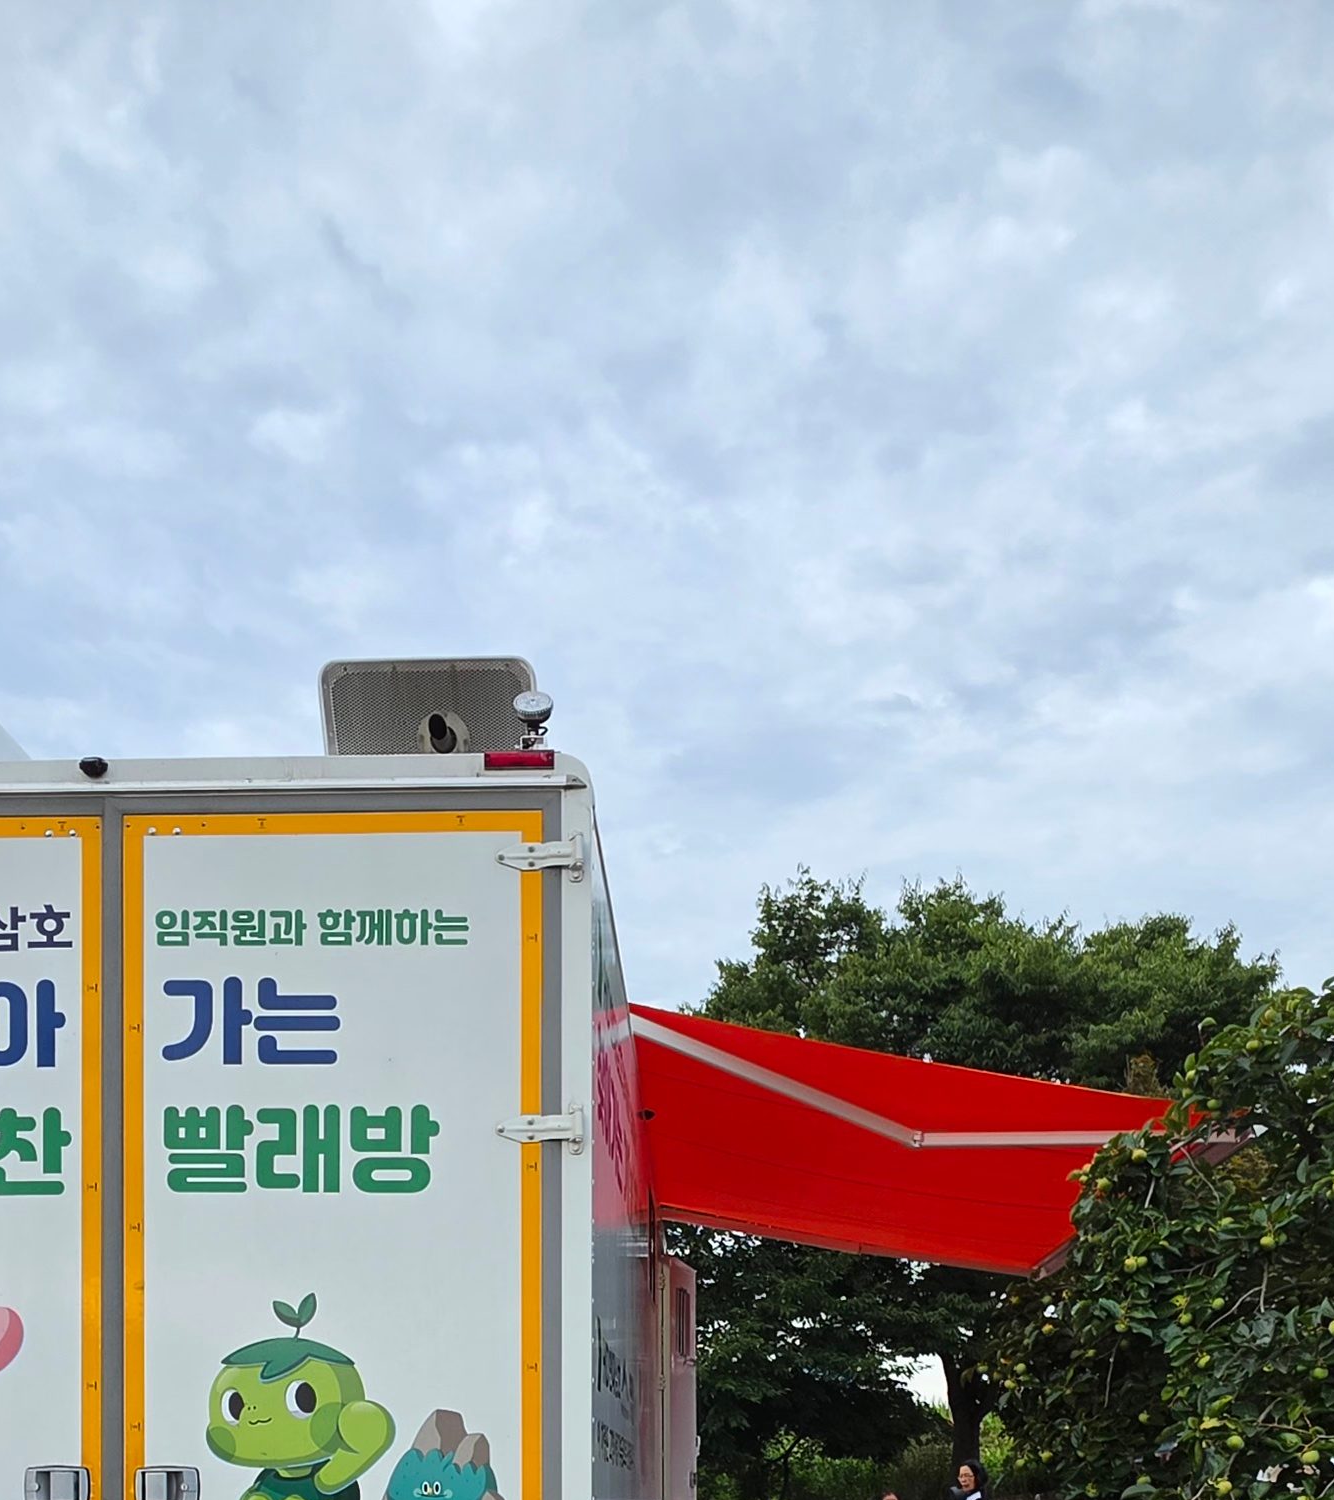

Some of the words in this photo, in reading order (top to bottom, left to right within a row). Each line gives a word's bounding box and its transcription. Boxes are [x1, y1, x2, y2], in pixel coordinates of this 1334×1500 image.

[155, 909, 307, 947] 임직원과
[317, 909, 469, 946] 함께하는
[162, 976, 341, 1065] 가는
[163, 1104, 440, 1194] 빨래방
